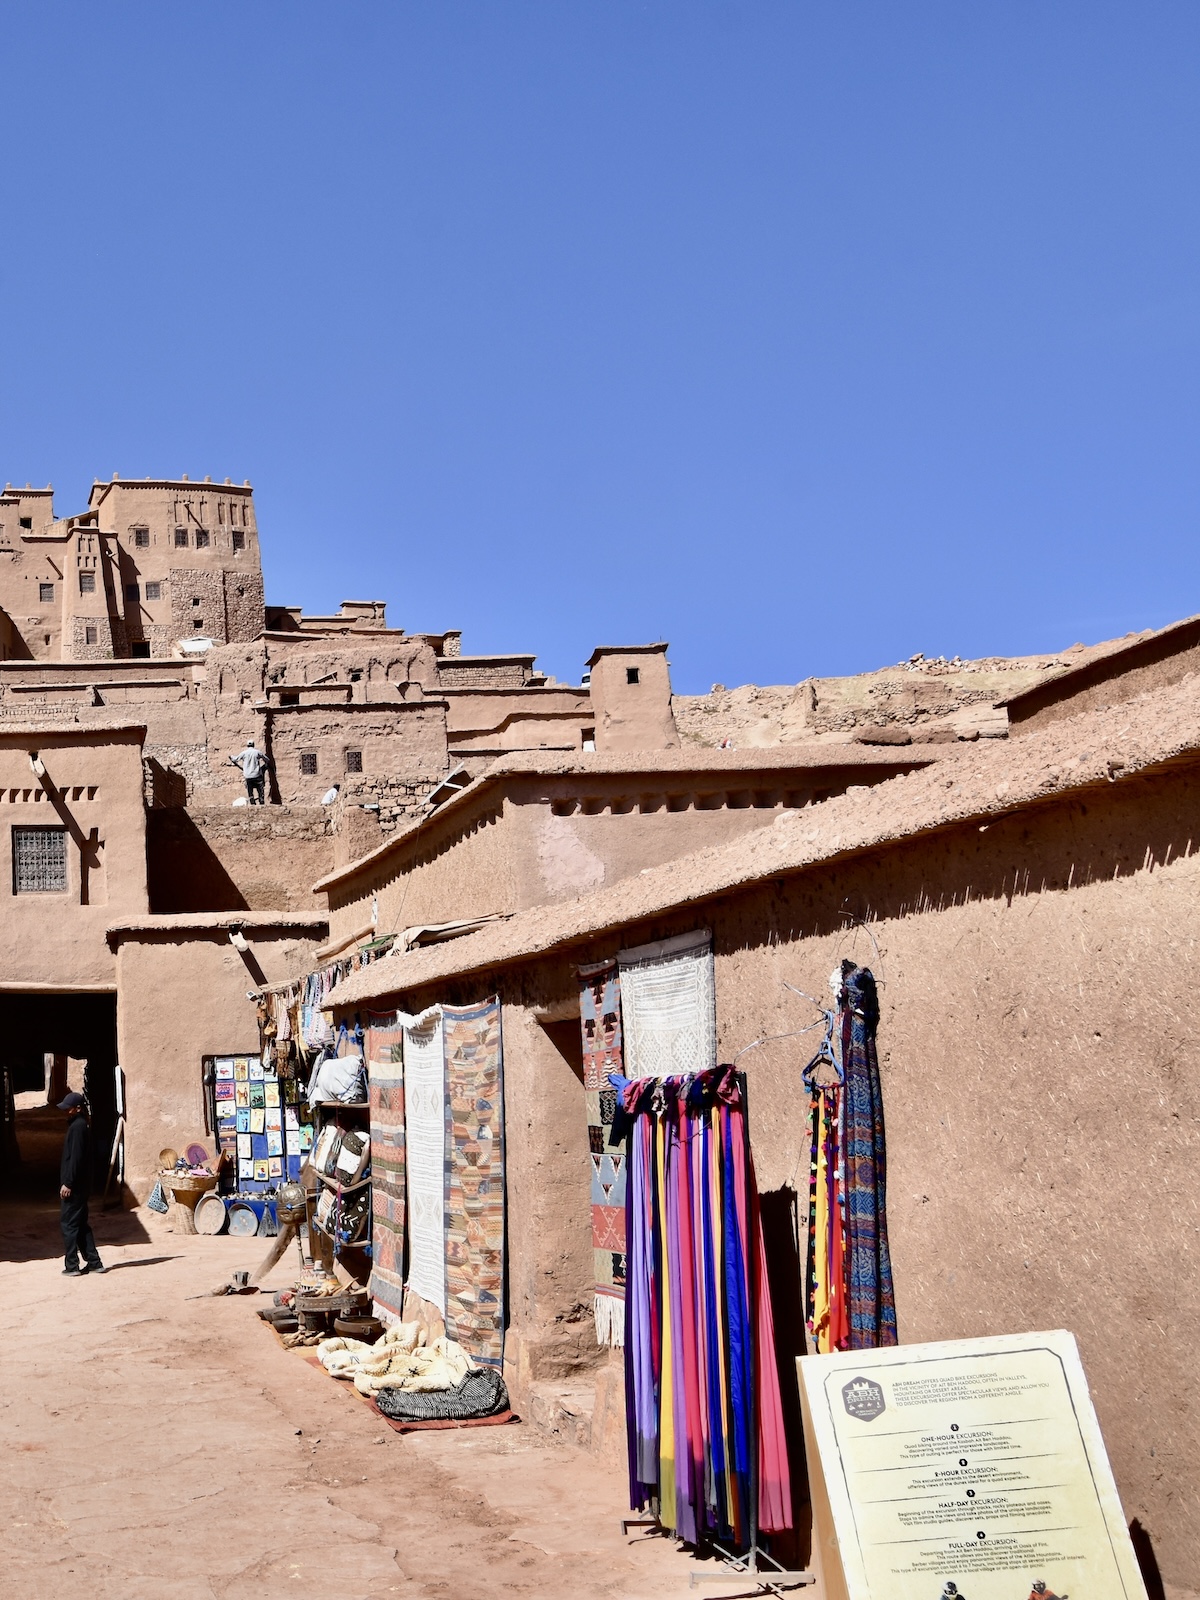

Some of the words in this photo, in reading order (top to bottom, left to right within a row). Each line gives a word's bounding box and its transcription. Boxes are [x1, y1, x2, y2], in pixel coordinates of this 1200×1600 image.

[967, 1372, 997, 1380] EXCURSIONS
[846, 1390, 880, 1399] ABH
[958, 1388, 992, 1396] SPECTACULAR
[847, 1396, 880, 1404] DREAM
[921, 1434, 955, 1443] ONE-HOUR
[956, 1431, 993, 1439] EXCURSION:
[961, 1467, 998, 1475] EXCURSION:
[971, 1497, 1008, 1506] EXCURSION:
[980, 1538, 1019, 1546] EXCURSION:
